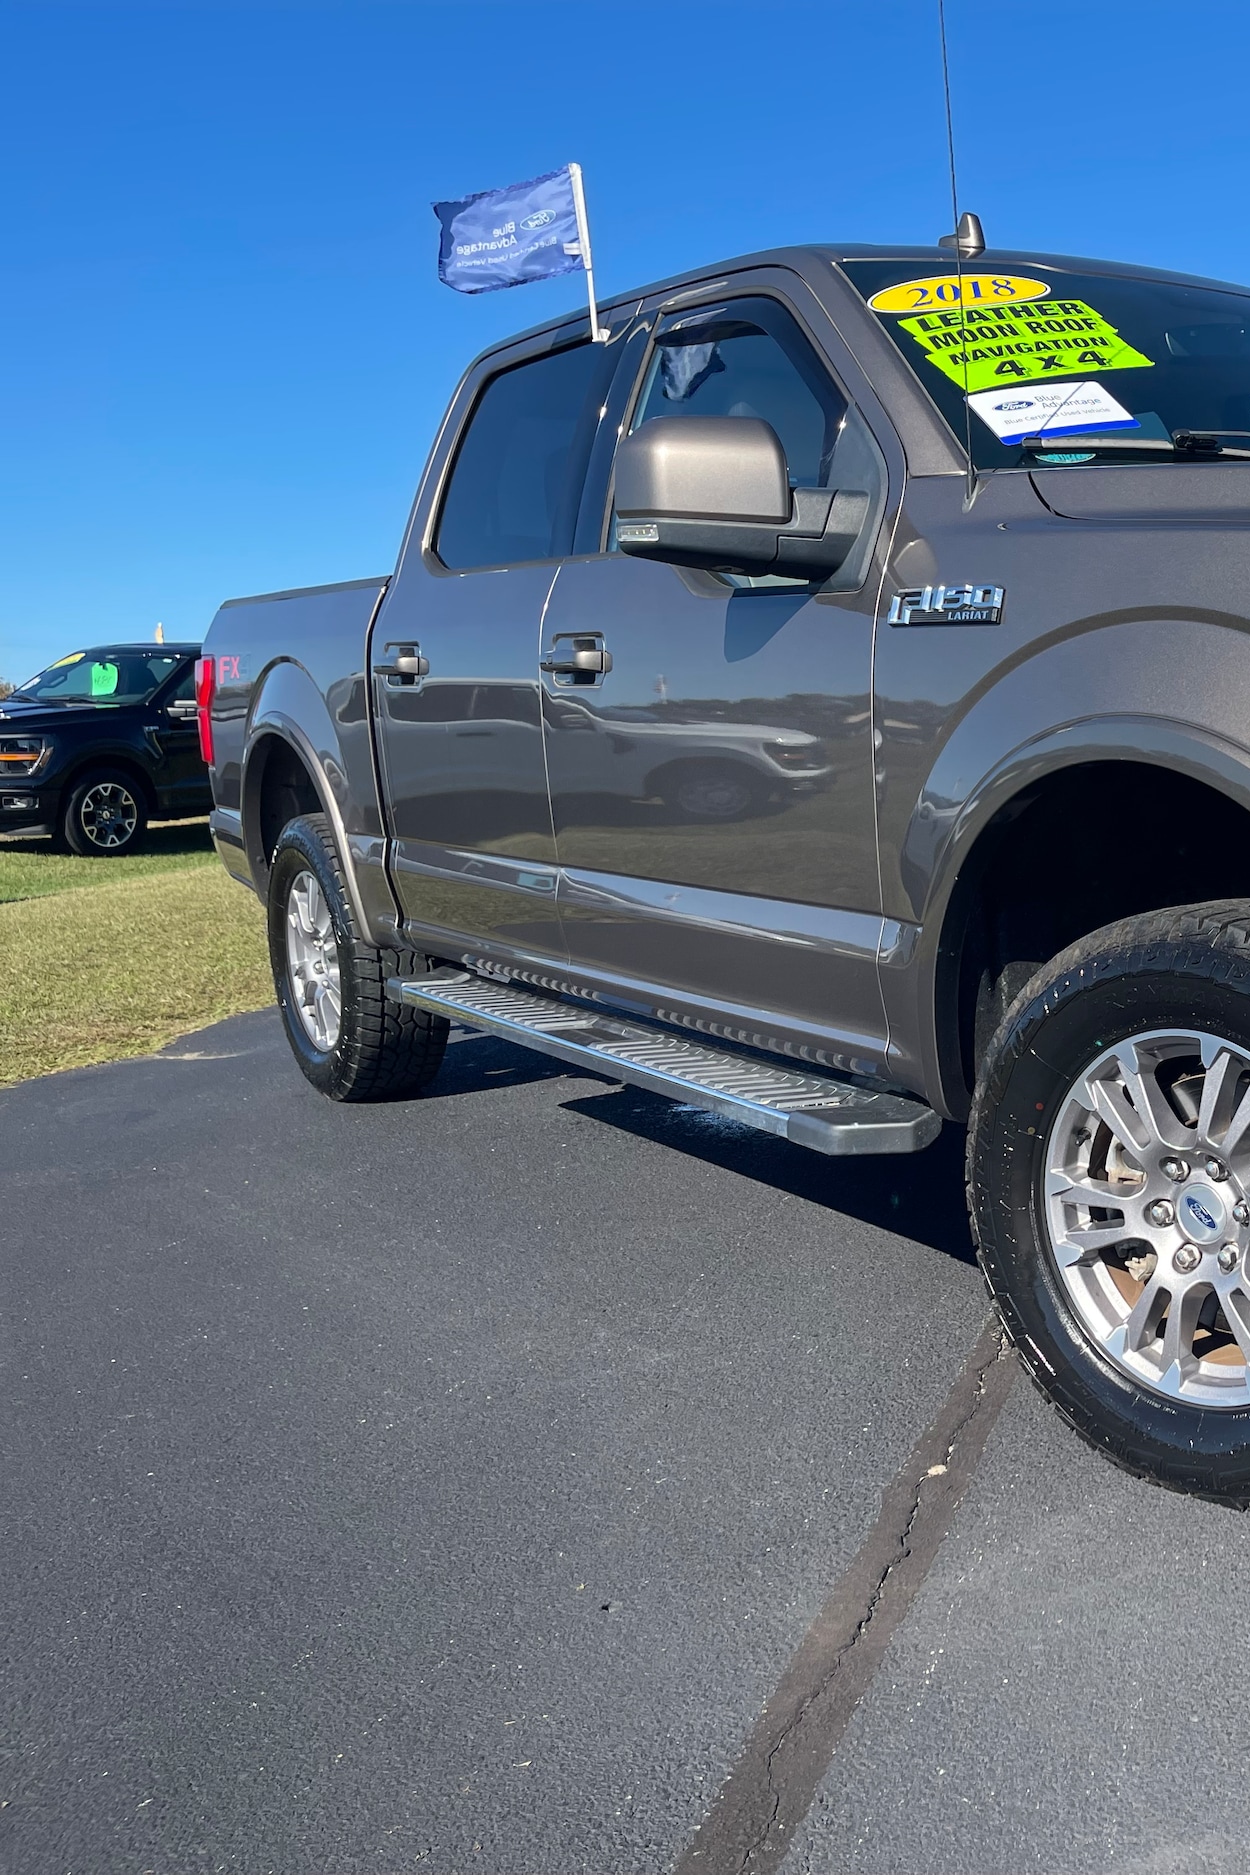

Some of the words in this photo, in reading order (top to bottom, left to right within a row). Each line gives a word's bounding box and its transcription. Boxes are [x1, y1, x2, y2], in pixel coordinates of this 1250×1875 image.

[906, 279, 1016, 308] 2018
[916, 302, 1085, 332] LEATHER
[926, 323, 1021, 350] MOON
[1023, 318, 1098, 335] ROOF
[948, 336, 1110, 366] NAVIGATION
[994, 359, 1027, 377] 4
[1077, 350, 1108, 367] 4
[1001, 400, 1029, 411] Ford
[1034, 394, 1062, 403] Blue
[1041, 397, 1102, 409] Advantage
[947, 609, 989, 620] LARIAT
